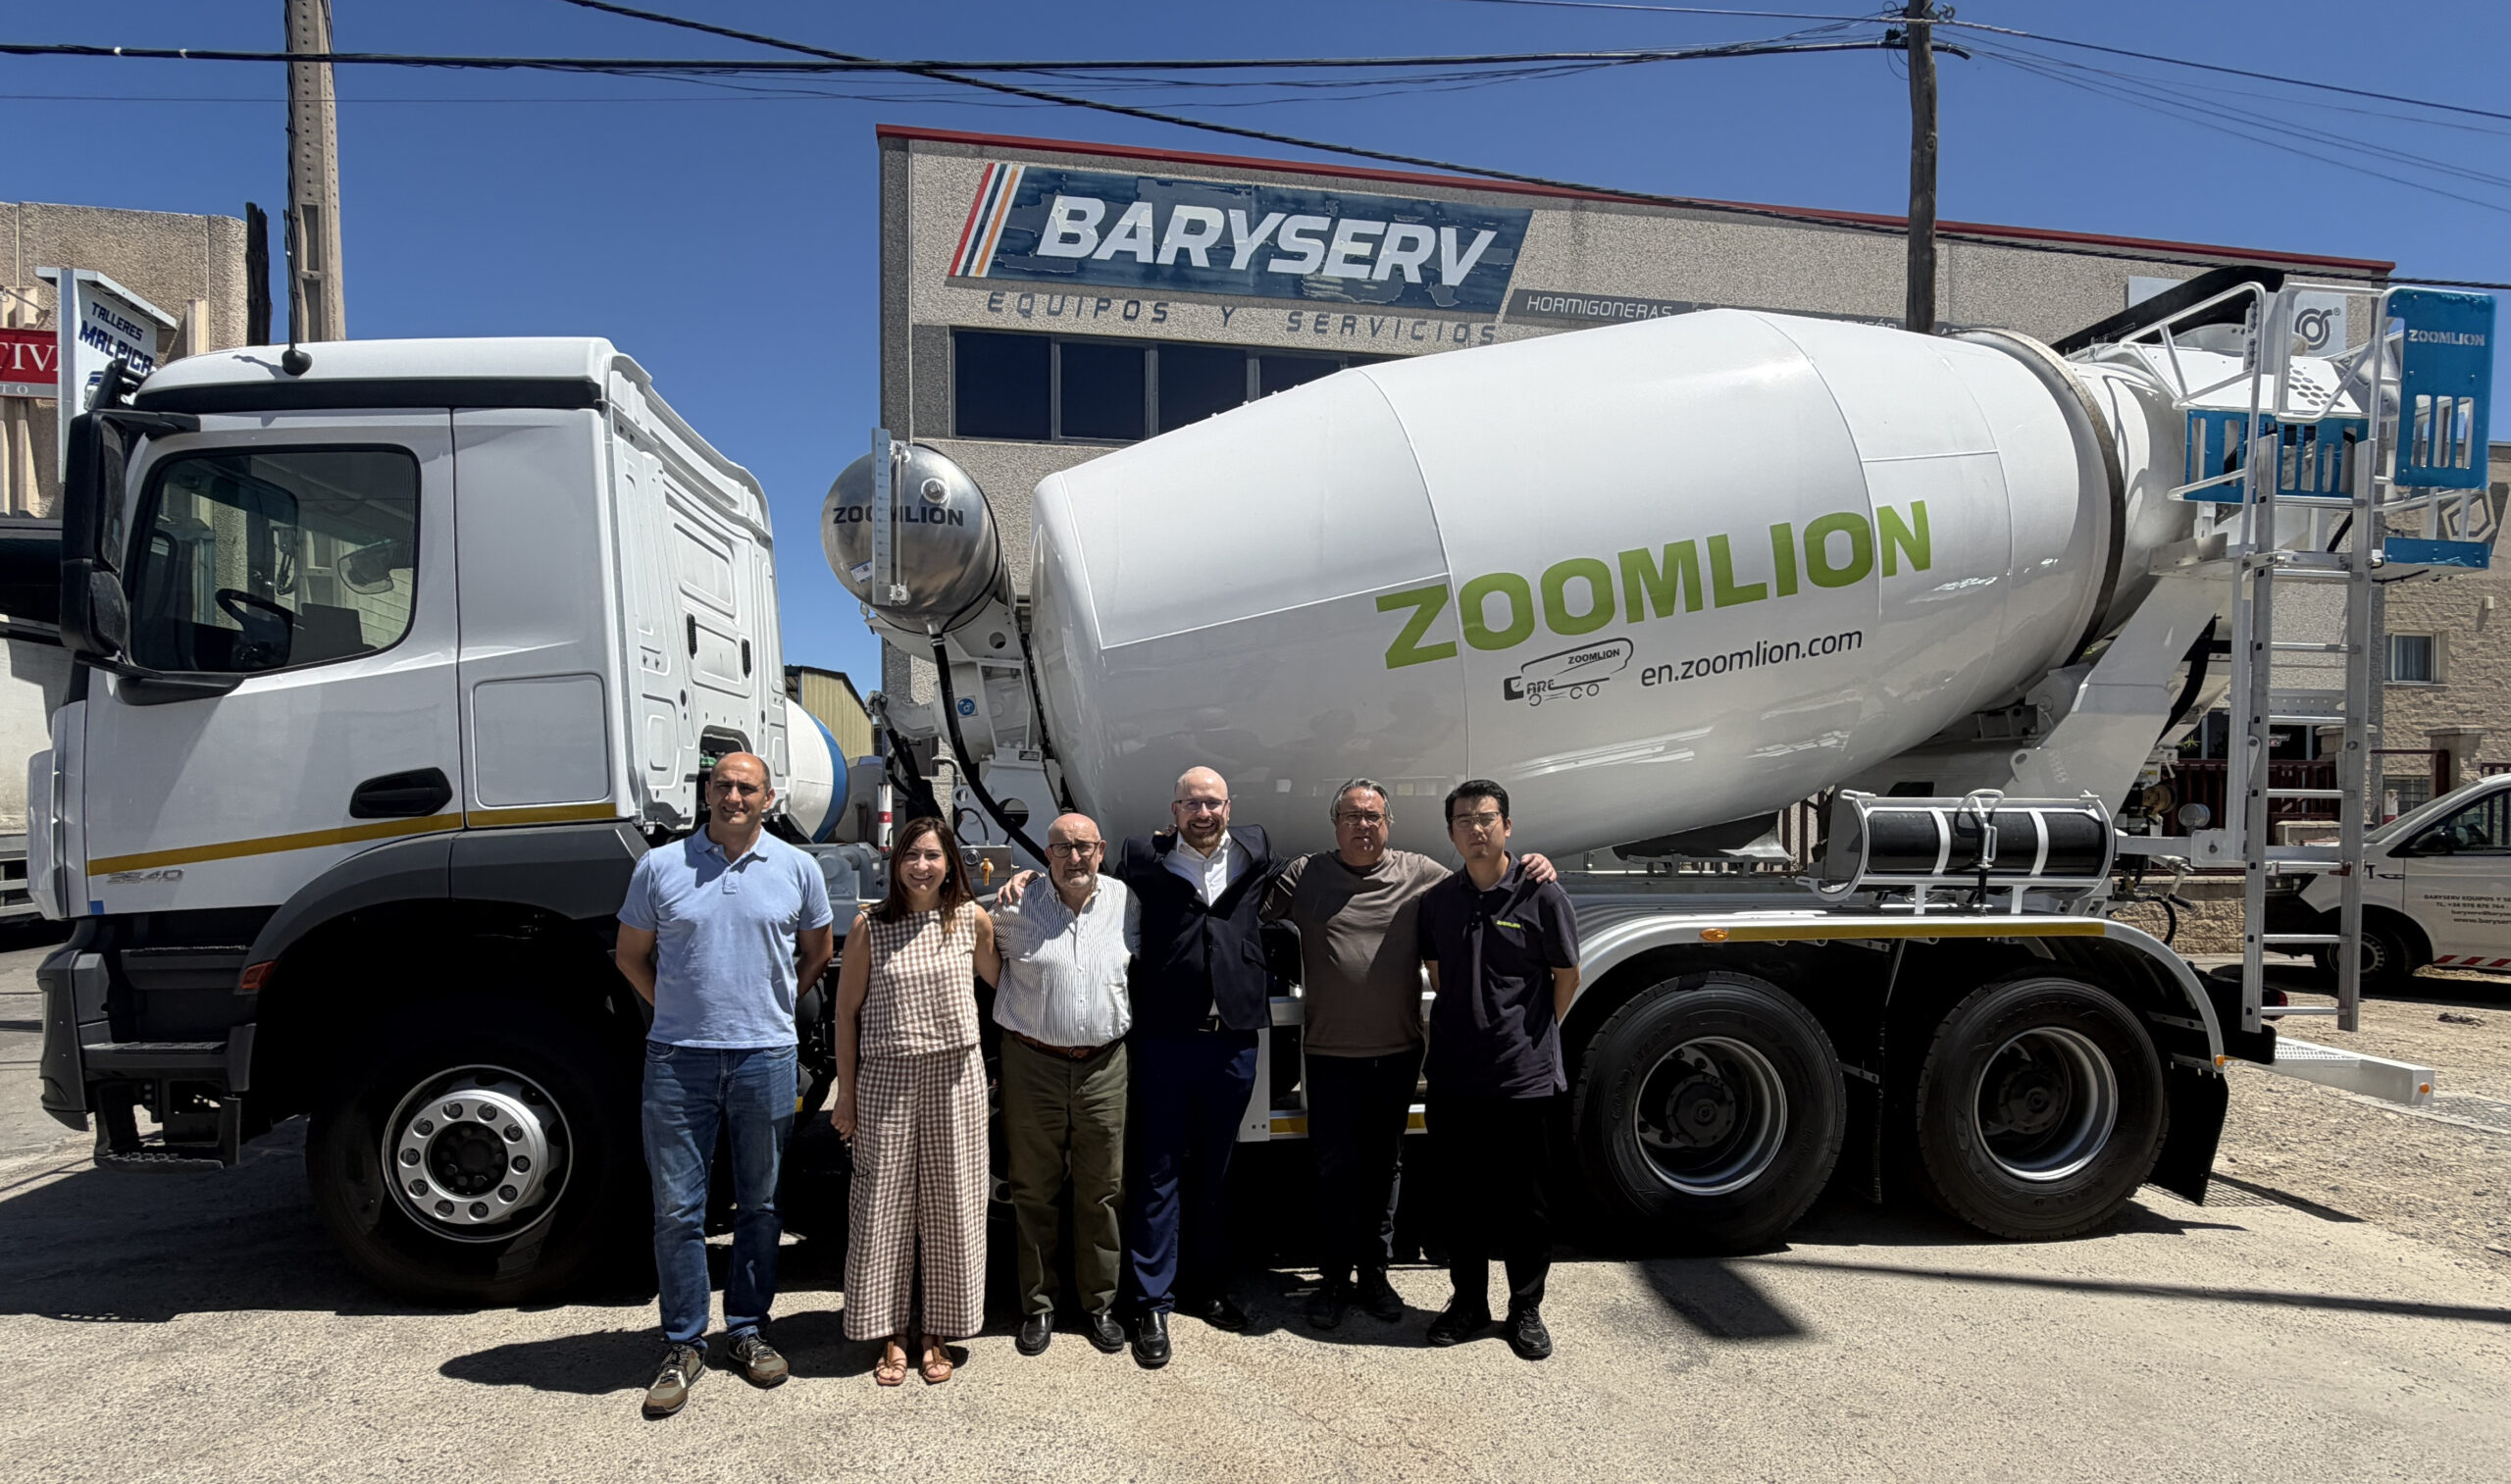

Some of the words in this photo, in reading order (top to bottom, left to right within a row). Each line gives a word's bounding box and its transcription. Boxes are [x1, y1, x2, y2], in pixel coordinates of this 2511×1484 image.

[1036, 194, 1497, 287] BARYSERV
[92, 301, 144, 341] TALLERES
[988, 291, 1169, 324] EQUIPOS
[1221, 306, 1237, 328] Y
[1286, 310, 1497, 344] SERVICIOS
[1526, 295, 1673, 320] HORMIGONERAS
[78, 320, 154, 374] MALPICA
[2408, 329, 2485, 346] ZOOMLION
[1374, 500, 1932, 670] ZOOMLION
[1567, 648, 1620, 665] ZOOMLION
[1641, 630, 1864, 687] en.zoomlion.com
